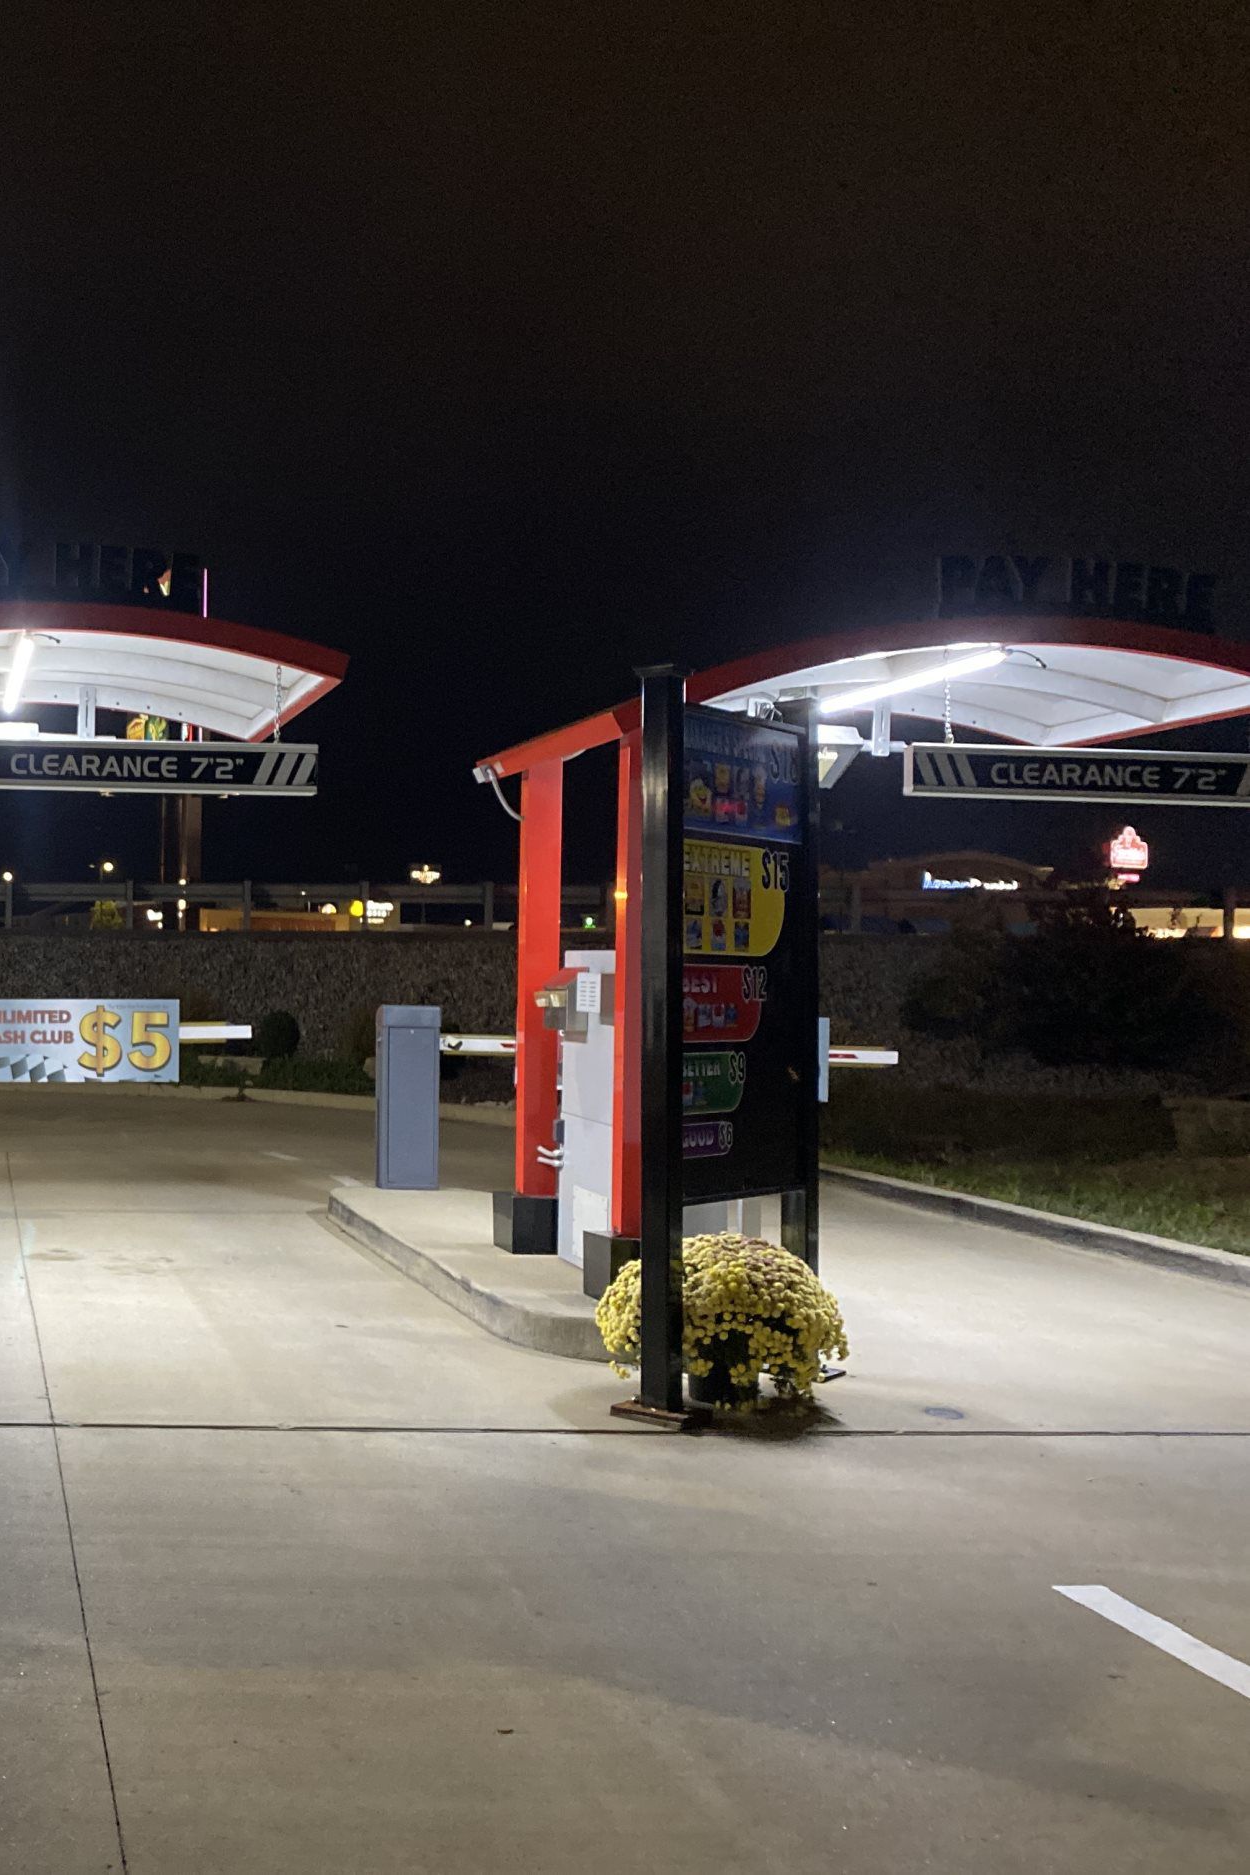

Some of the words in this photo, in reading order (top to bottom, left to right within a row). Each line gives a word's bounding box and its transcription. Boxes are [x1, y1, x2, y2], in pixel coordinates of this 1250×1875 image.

[10, 753, 178, 779] CLEARANCE
[190, 757, 244, 780] 7'2"
[990, 761, 1160, 788] CLEARANCE
[761, 847, 790, 893] $15
[742, 965, 767, 1004] $12
[29, 1030, 75, 1045] CLUB
[77, 1005, 172, 1077] $5
[729, 1051, 746, 1084] $9
